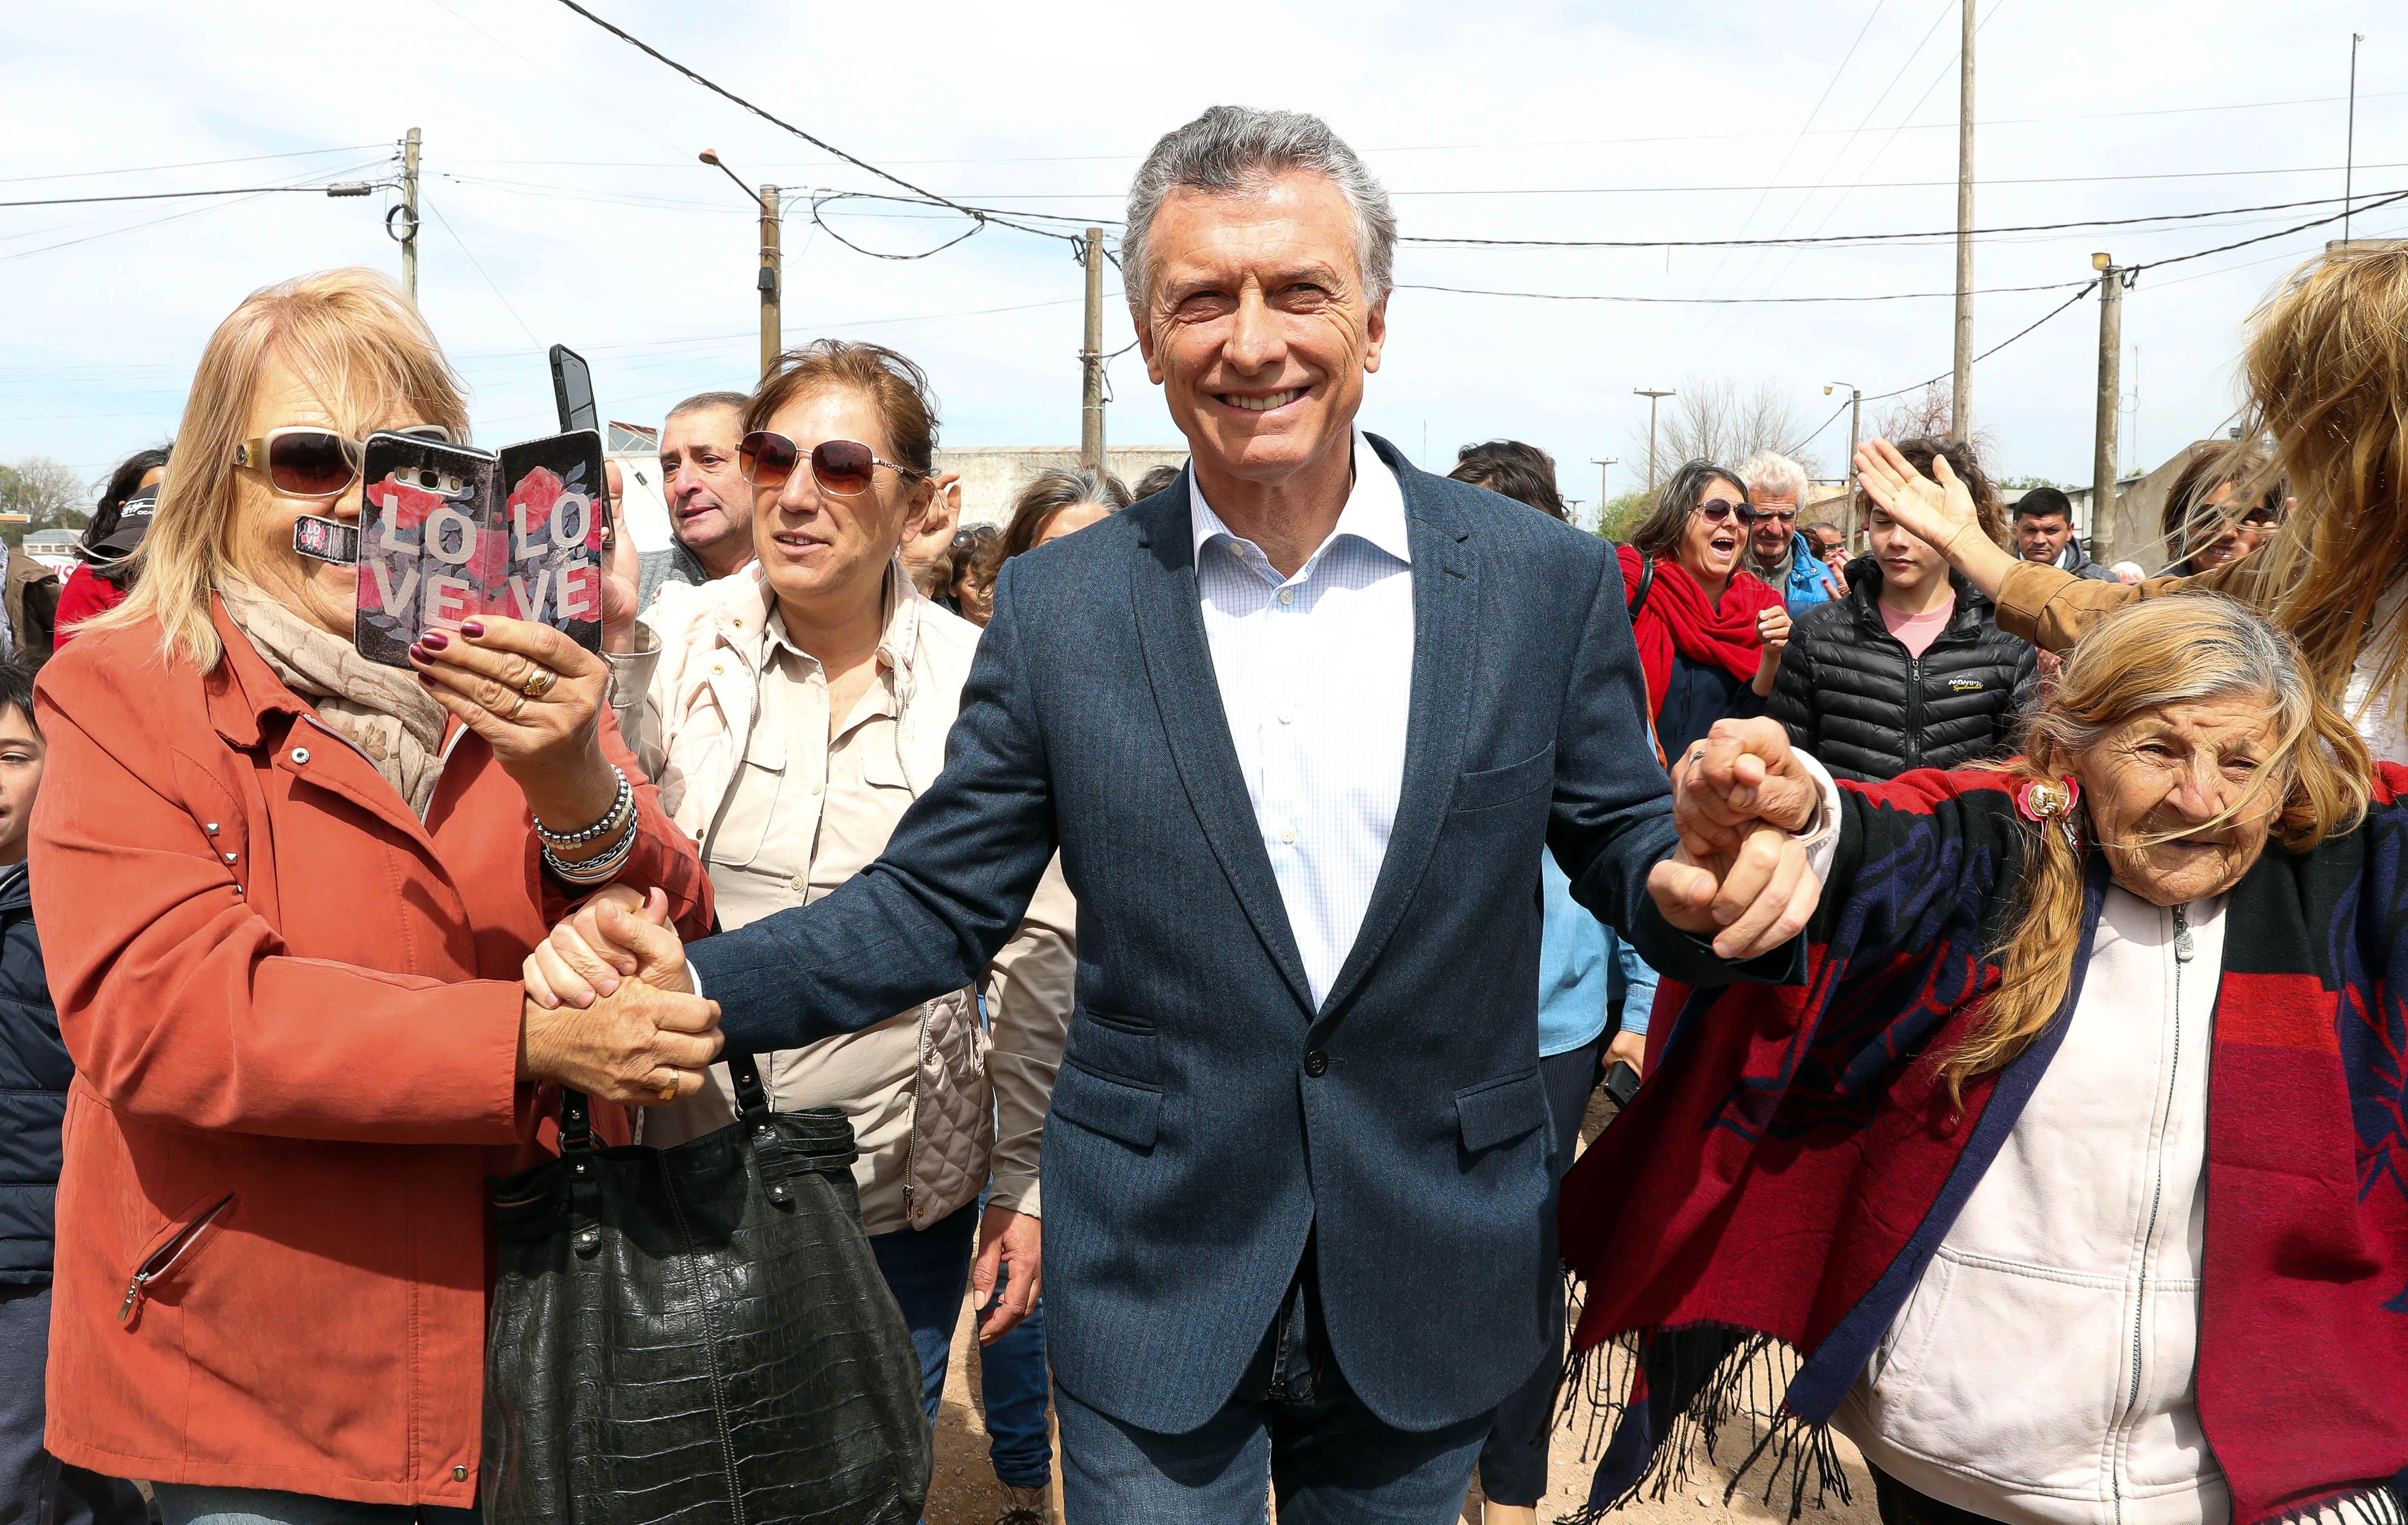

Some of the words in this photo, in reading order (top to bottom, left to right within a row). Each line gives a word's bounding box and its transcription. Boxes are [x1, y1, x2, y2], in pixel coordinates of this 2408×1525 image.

[306, 534, 319, 547] VE
[307, 522, 321, 535] LO
[380, 493, 477, 564] LO
[514, 492, 591, 561] LO
[370, 557, 470, 631] VE
[509, 557, 590, 621] VE
